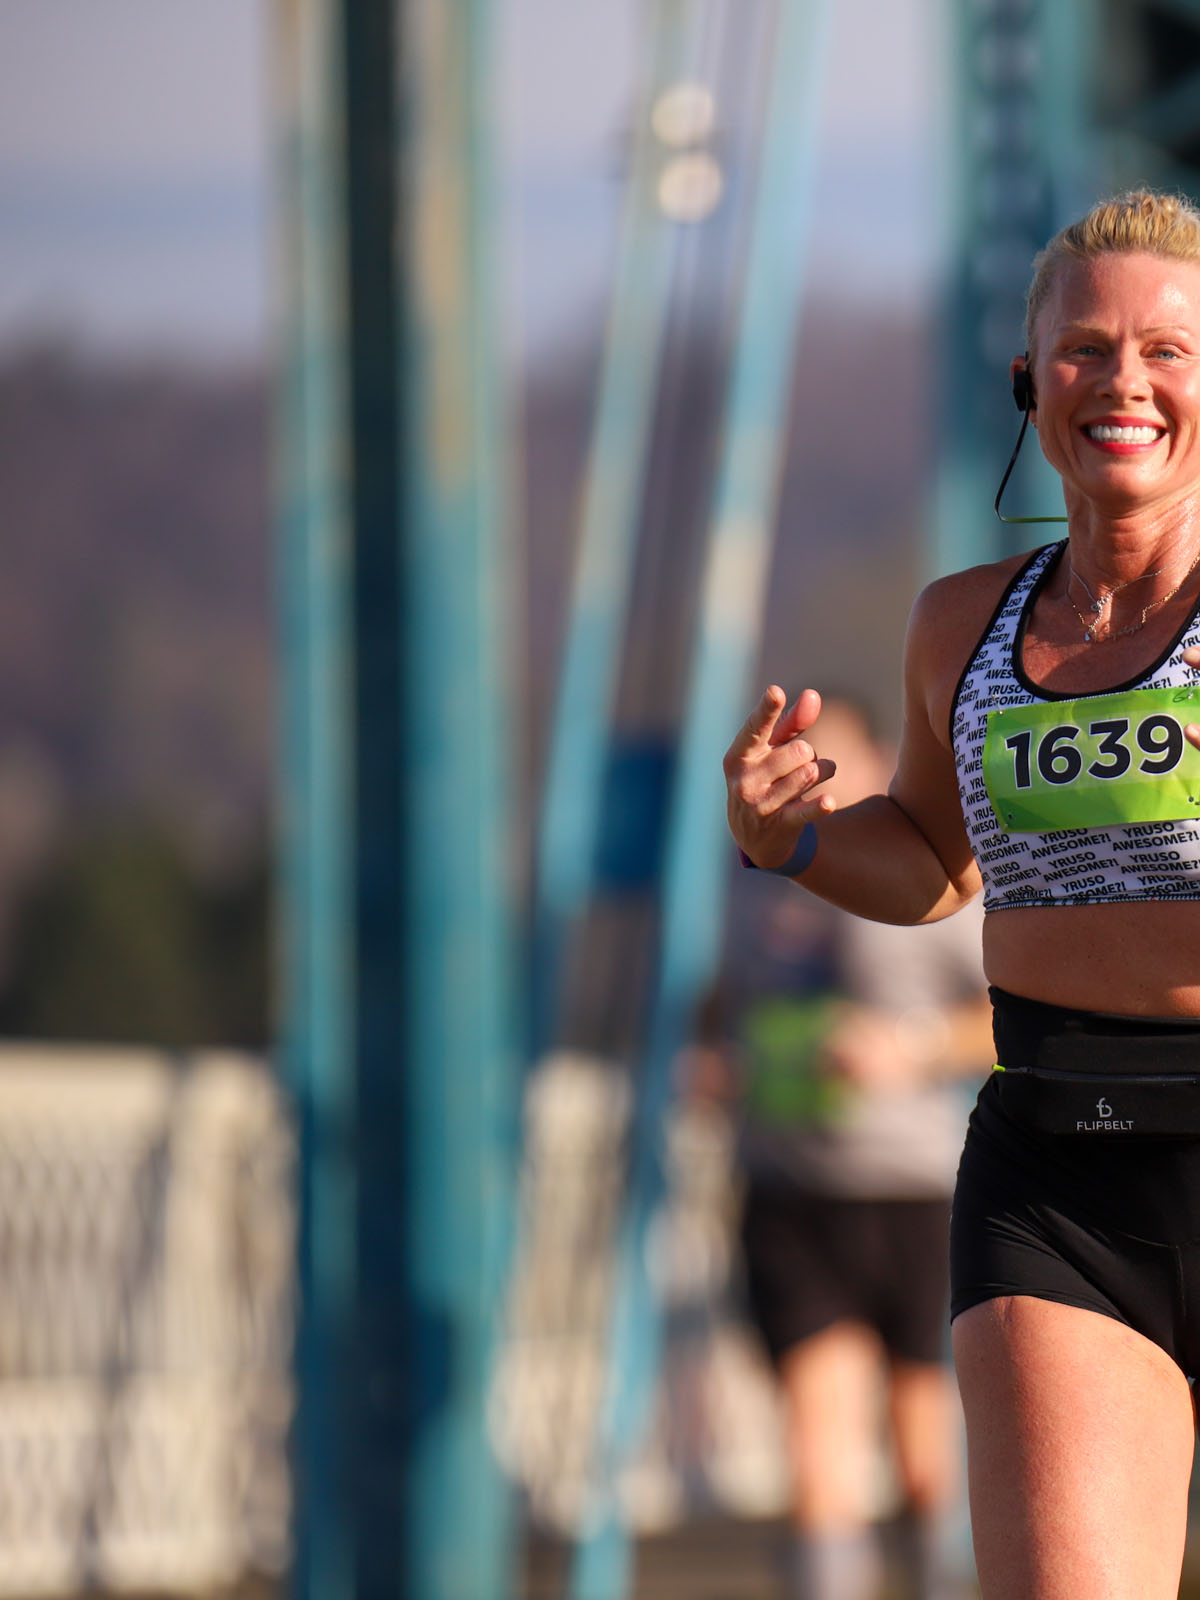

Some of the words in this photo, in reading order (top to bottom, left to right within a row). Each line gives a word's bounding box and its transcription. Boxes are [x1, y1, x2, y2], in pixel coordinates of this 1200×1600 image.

[987, 684, 1024, 696] YRUSO
[973, 694, 1035, 711] AWESOME?!
[1005, 713, 1185, 789] 1639
[973, 805, 996, 822] YRUS
[1039, 827, 1089, 845] YRUSO
[1122, 821, 1175, 839] YRUSO
[1031, 832, 1112, 860] AWESOME?!
[1112, 830, 1199, 852] AWESOME?!
[980, 841, 1030, 864] AWESOME?!
[1048, 850, 1096, 870] YRUSO
[1129, 850, 1181, 864] YRUSO
[990, 861, 1020, 878] YRUSO
[992, 866, 1041, 889] AWESOME?!
[1043, 857, 1119, 883] AWESOME?!
[1061, 874, 1105, 894] YRUSO
[1076, 1120, 1134, 1131] FLIPBELT
